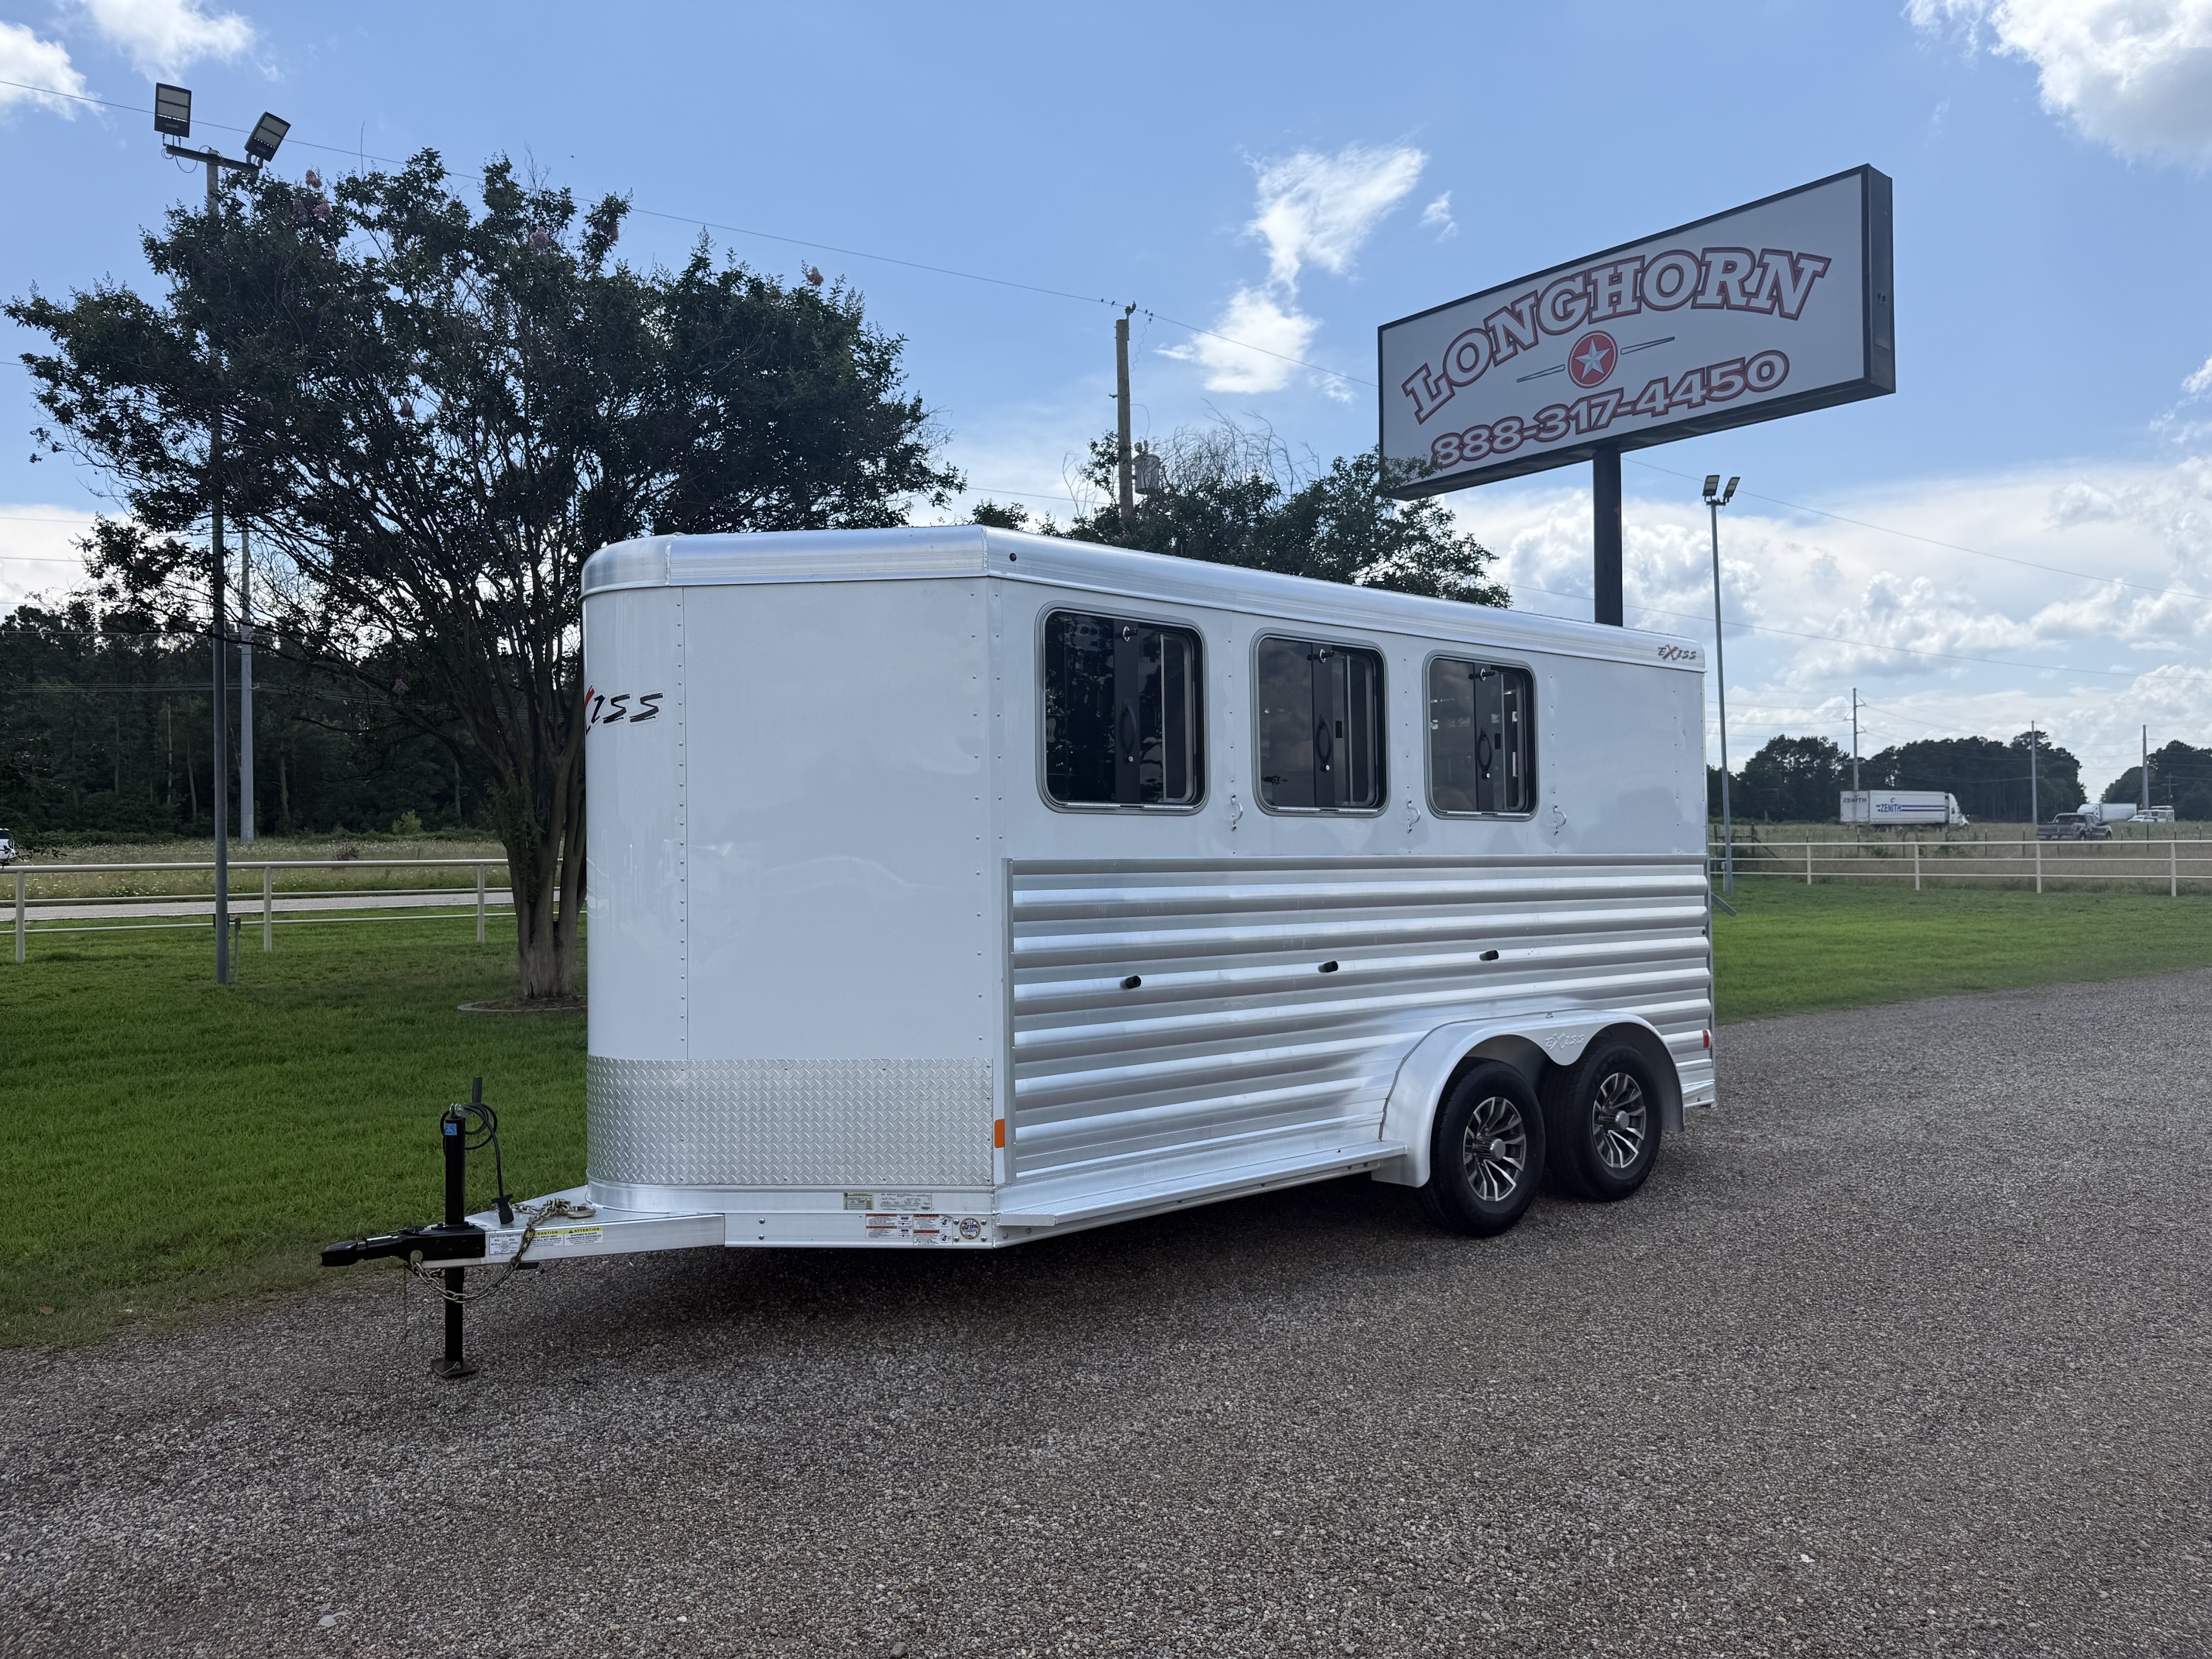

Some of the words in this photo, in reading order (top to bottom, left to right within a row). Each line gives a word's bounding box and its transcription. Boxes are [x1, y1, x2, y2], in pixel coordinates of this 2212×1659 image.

[1402, 246, 1832, 424] LONGHORN
[1431, 349, 1789, 469] 888-317-4450
[1881, 804, 1902, 812] ZENITH
